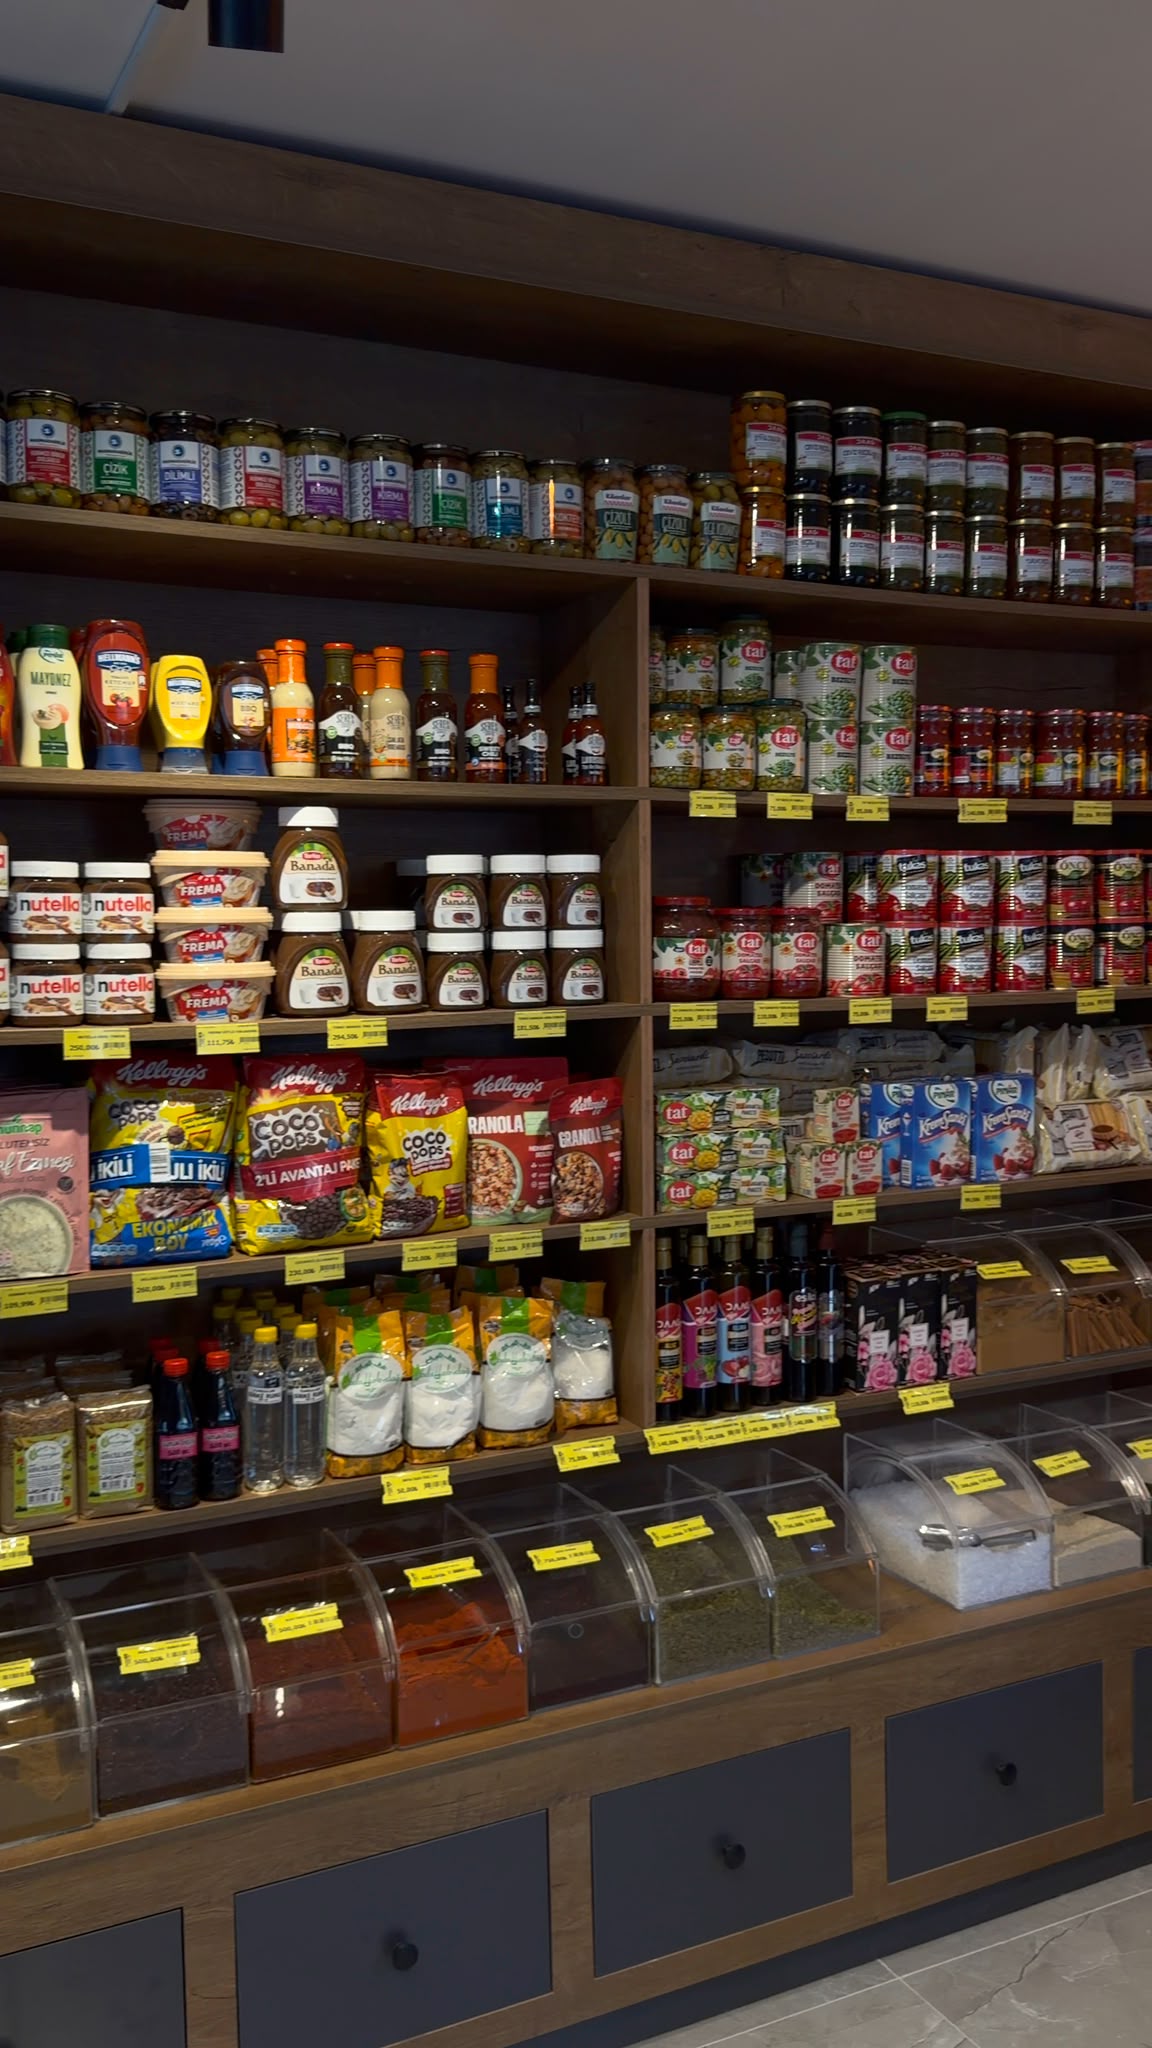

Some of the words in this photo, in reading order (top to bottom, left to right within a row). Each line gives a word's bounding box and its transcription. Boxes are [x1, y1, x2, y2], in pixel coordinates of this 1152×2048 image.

[748, 648, 766, 659] tat
[30, 671, 71, 687] MAYONEZ
[776, 731, 799, 743] tat
[167, 830, 207, 842] FREMA
[291, 860, 336, 872] Banada
[180, 885, 223, 896] FREMA
[20, 896, 79, 912] nutella
[94, 895, 153, 912] nutella
[441, 897, 476, 906] Banada
[511, 896, 543, 905] Banada
[182, 941, 225, 953] FREMA
[688, 944, 707, 954] tat
[739, 938, 762, 950] tat
[796, 938, 817, 950] tat
[301, 966, 343, 977] Banada
[379, 964, 417, 976] Banada
[516, 973, 545, 981] Banada
[571, 971, 601, 979] Banada
[447, 974, 481, 983] Banada
[20, 979, 80, 995] nutella
[98, 978, 154, 994] nutella
[186, 995, 229, 1009] FREMA
[117, 1060, 208, 1086] Kellogg's
[270, 1064, 347, 1092] Kellogg's
[472, 1075, 544, 1098] Kellogg's
[390, 1092, 449, 1114] Kellogg's
[569, 1096, 609, 1115] Kellogg's
[118, 1111, 157, 1129] pops
[666, 1106, 688, 1120] tat
[467, 1115, 524, 1134] RANOLA
[268, 1130, 318, 1157] pops
[410, 1146, 444, 1162] pops
[671, 1146, 694, 1159] tat
[279, 1162, 338, 1184] AVANTAJ
[669, 1186, 692, 1199] tat
[131, 1209, 218, 1238] EKONOMİK
[153, 1234, 189, 1252] BOY
